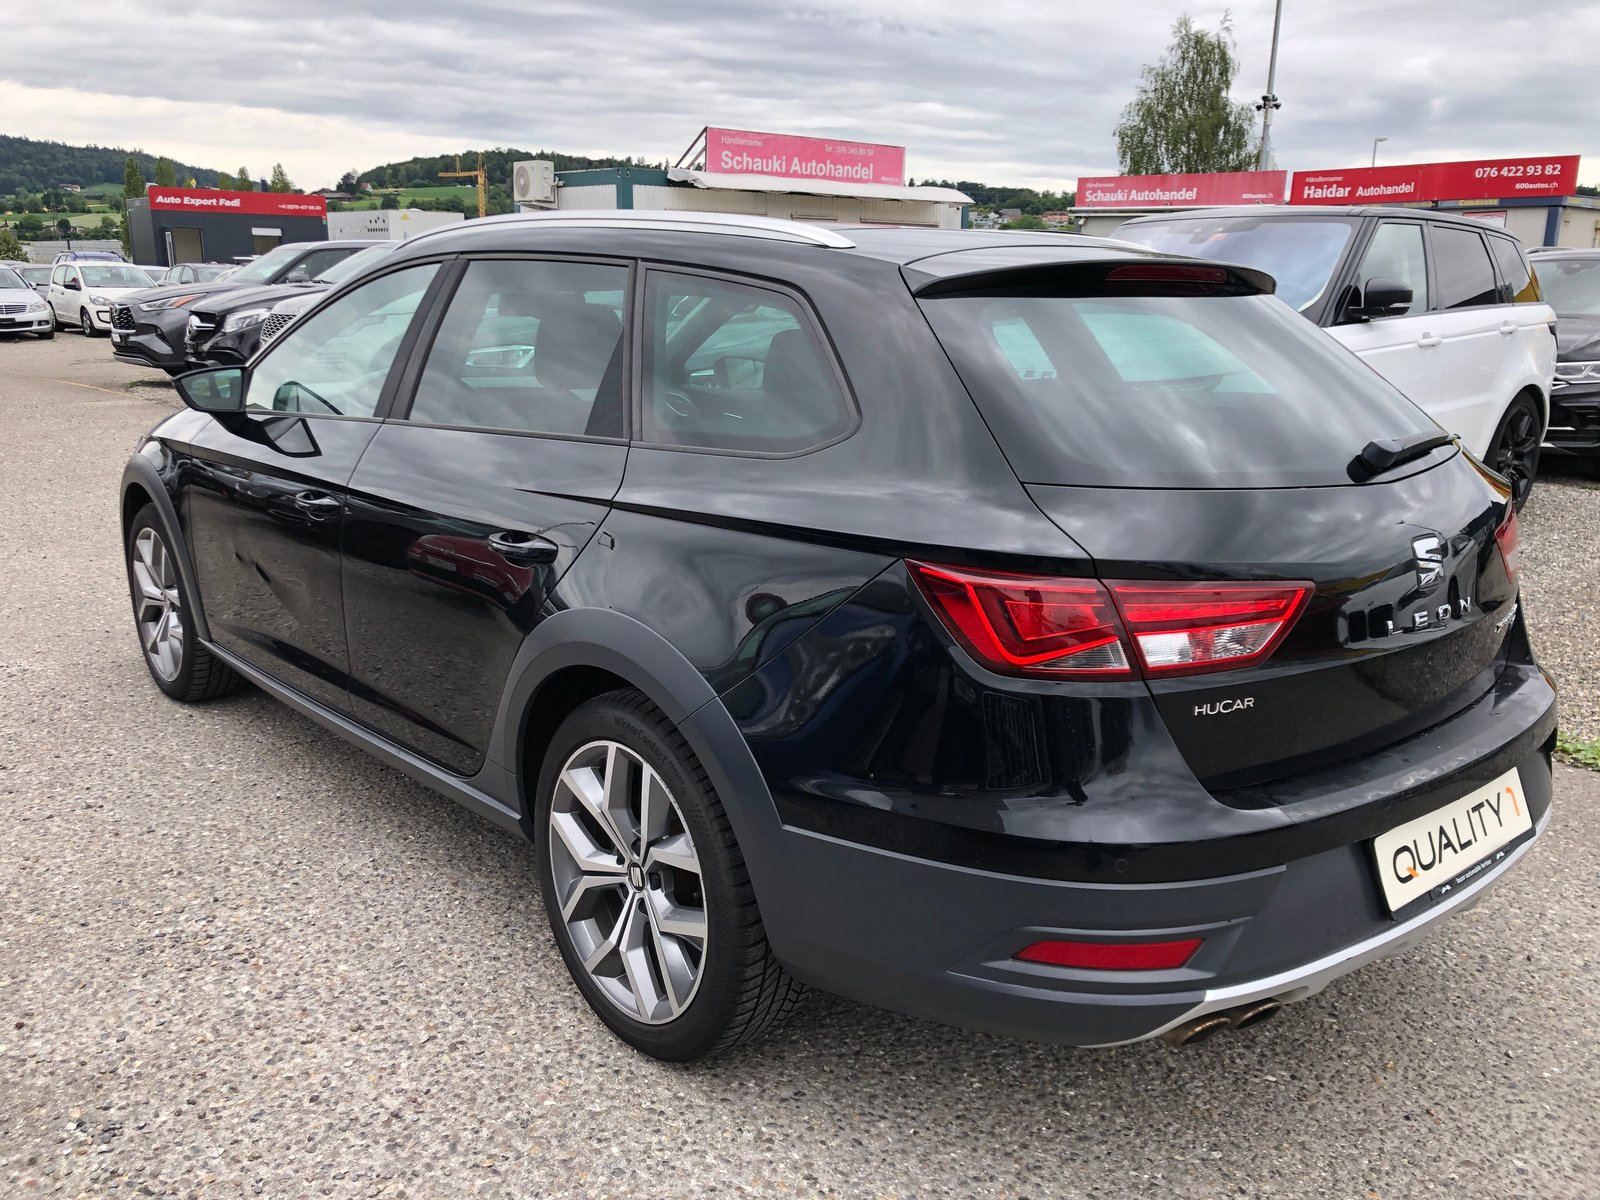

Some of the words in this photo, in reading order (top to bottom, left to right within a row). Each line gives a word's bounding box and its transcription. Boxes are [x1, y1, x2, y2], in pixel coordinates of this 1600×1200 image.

[721, 150, 786, 173] Schauki
[789, 157, 873, 180] Autohandel
[1475, 168, 1498, 178] 076
[1500, 166, 1524, 176] 422
[1527, 165, 1542, 176] 93
[1544, 164, 1561, 175] 82
[1303, 184, 1351, 198] Haidar
[1356, 182, 1415, 197] Autohandel
[1515, 181, 1558, 189] 600autos.ch
[156, 195, 181, 204] Auto
[183, 196, 217, 206] Export
[219, 198, 240, 207] Fadi
[1085, 189, 1128, 202] Schauki
[1129, 187, 1197, 201] Autohandel
[1387, 597, 1472, 635] LEON
[1194, 697, 1255, 716] HUCAR
